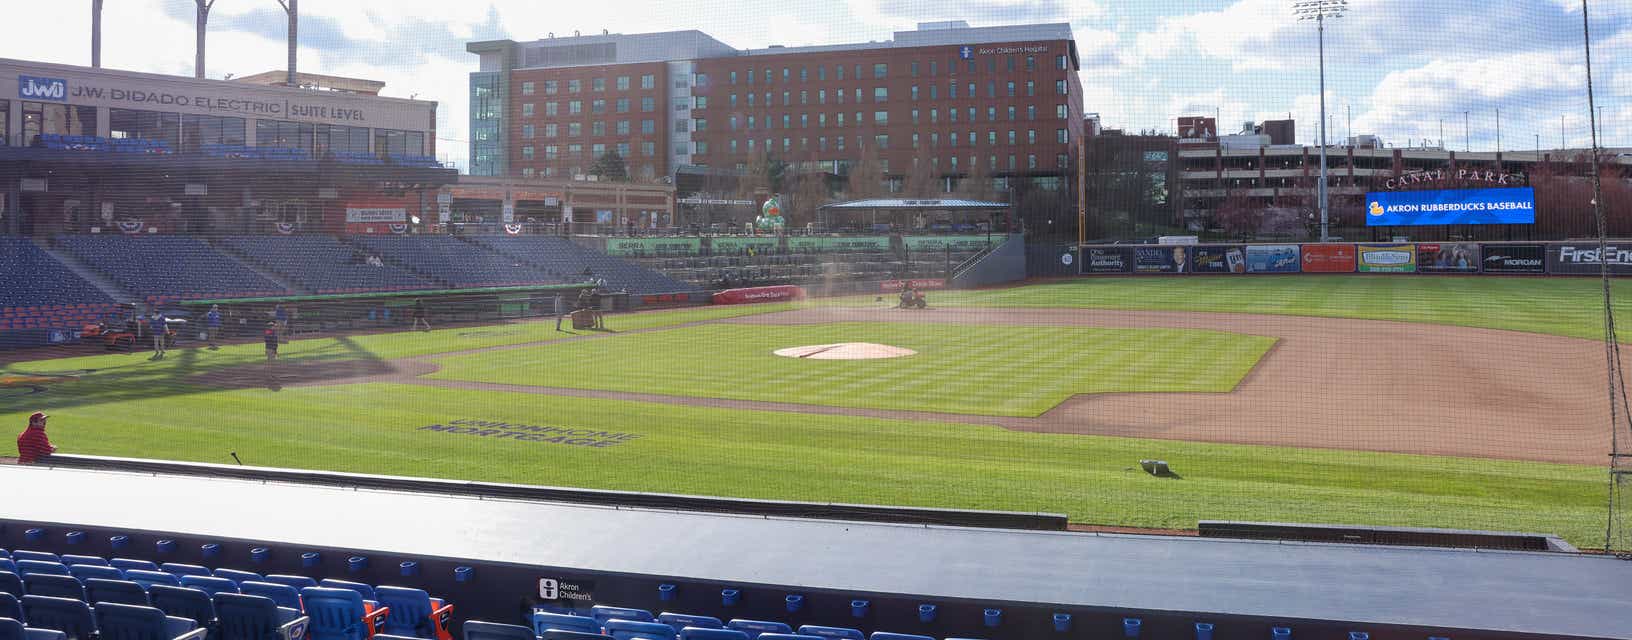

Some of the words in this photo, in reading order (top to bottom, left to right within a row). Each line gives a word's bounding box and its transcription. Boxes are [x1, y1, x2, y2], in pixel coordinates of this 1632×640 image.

[72, 86, 105, 99] J.W.
[110, 88, 189, 106] DIDADO
[195, 97, 281, 114] ELECTRIC
[291, 104, 327, 118] SUITE
[331, 107, 365, 121] LEVEL
[1385, 169, 1445, 190] CANAL
[1458, 169, 1509, 185] PARK
[1387, 204, 1419, 213] AKRON
[1421, 202, 1485, 212] RUBBERDUCKS
[1487, 201, 1533, 210] BASEBALL
[416, 424, 623, 448] MORTGAGE
[559, 582, 579, 591] Akron
[559, 590, 592, 601] Children's
